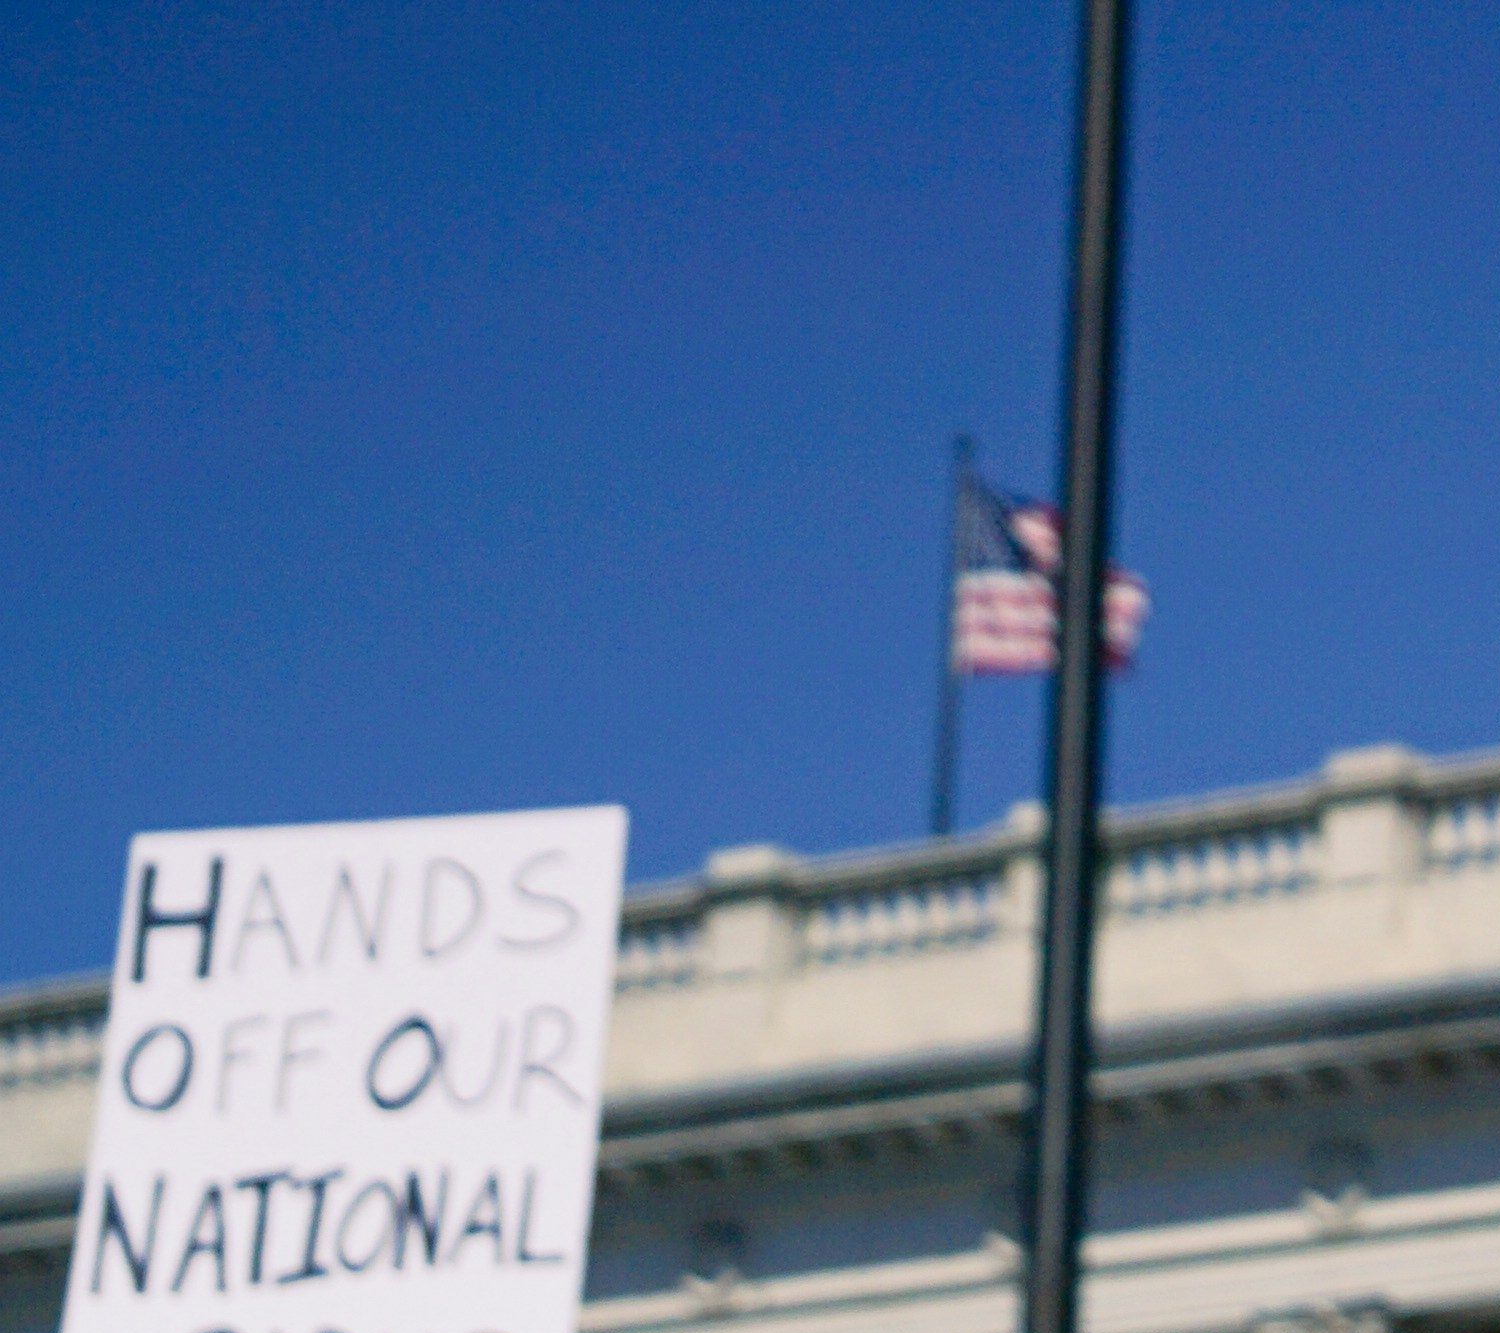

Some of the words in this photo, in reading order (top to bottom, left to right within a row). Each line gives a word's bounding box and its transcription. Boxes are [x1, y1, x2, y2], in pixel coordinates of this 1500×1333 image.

[130, 848, 583, 984] HANDS
[122, 1008, 332, 1116] OFF
[366, 1004, 588, 1114] OUR
[91, 1163, 567, 1295] NATIONAL
